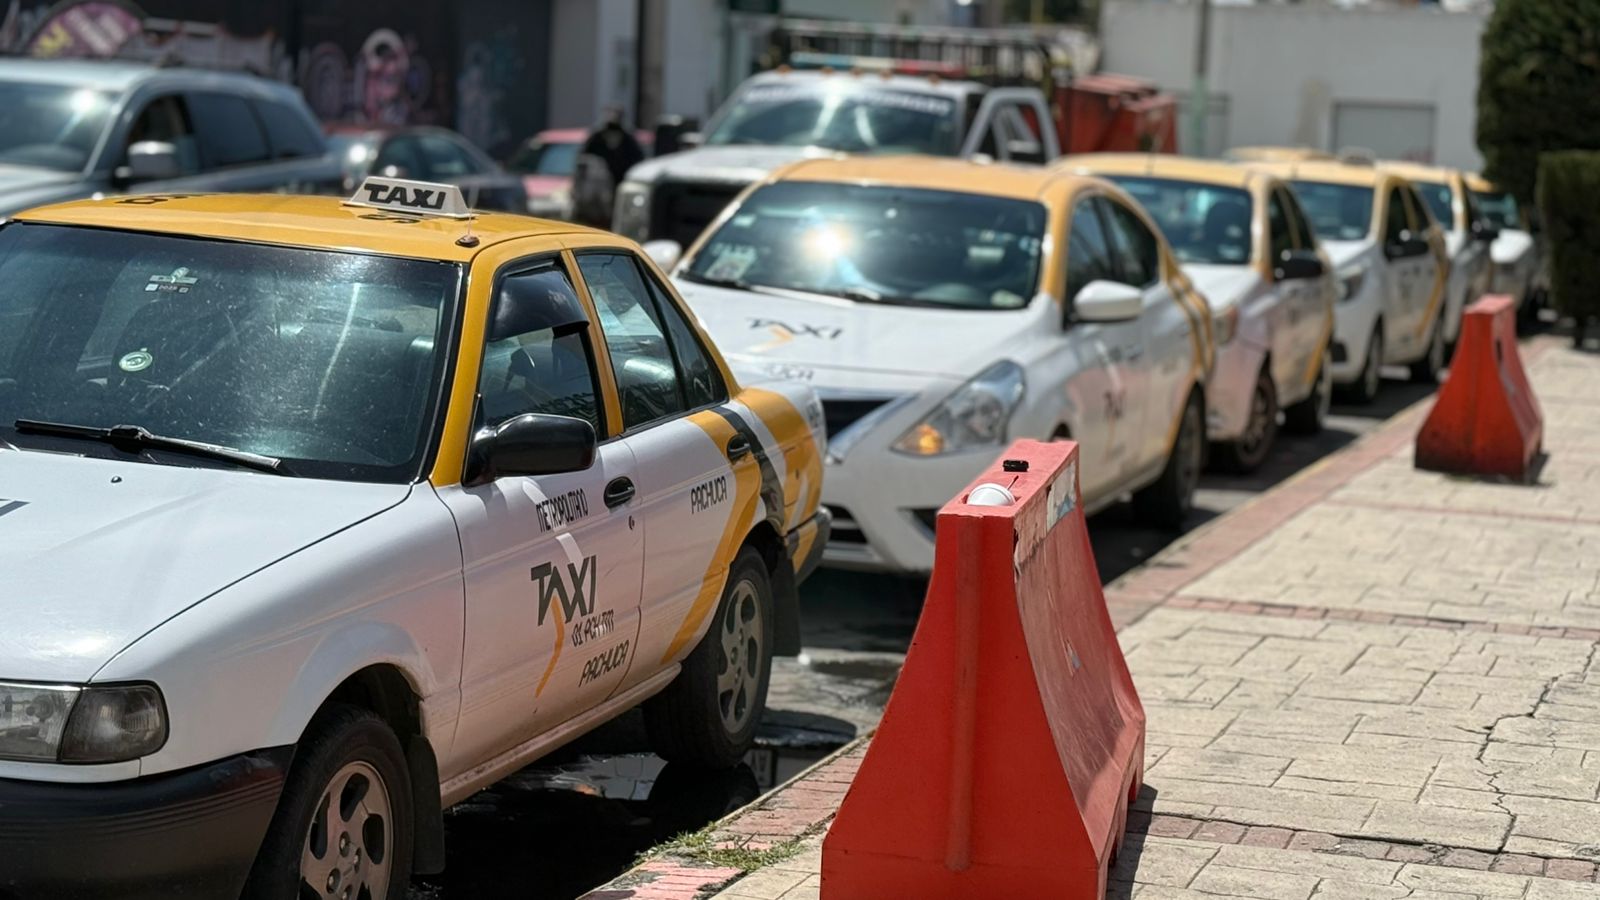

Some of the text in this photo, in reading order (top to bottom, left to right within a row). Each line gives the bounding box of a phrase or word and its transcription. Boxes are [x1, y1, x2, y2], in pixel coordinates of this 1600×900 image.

[364, 183, 446, 210] TAXI
[744, 317, 843, 339] TAXI
[536, 488, 589, 533] METROPOLITANO
[691, 475, 728, 515] PACHUCA
[531, 555, 596, 627] TAXI
[578, 640, 630, 688] PACHUCA
